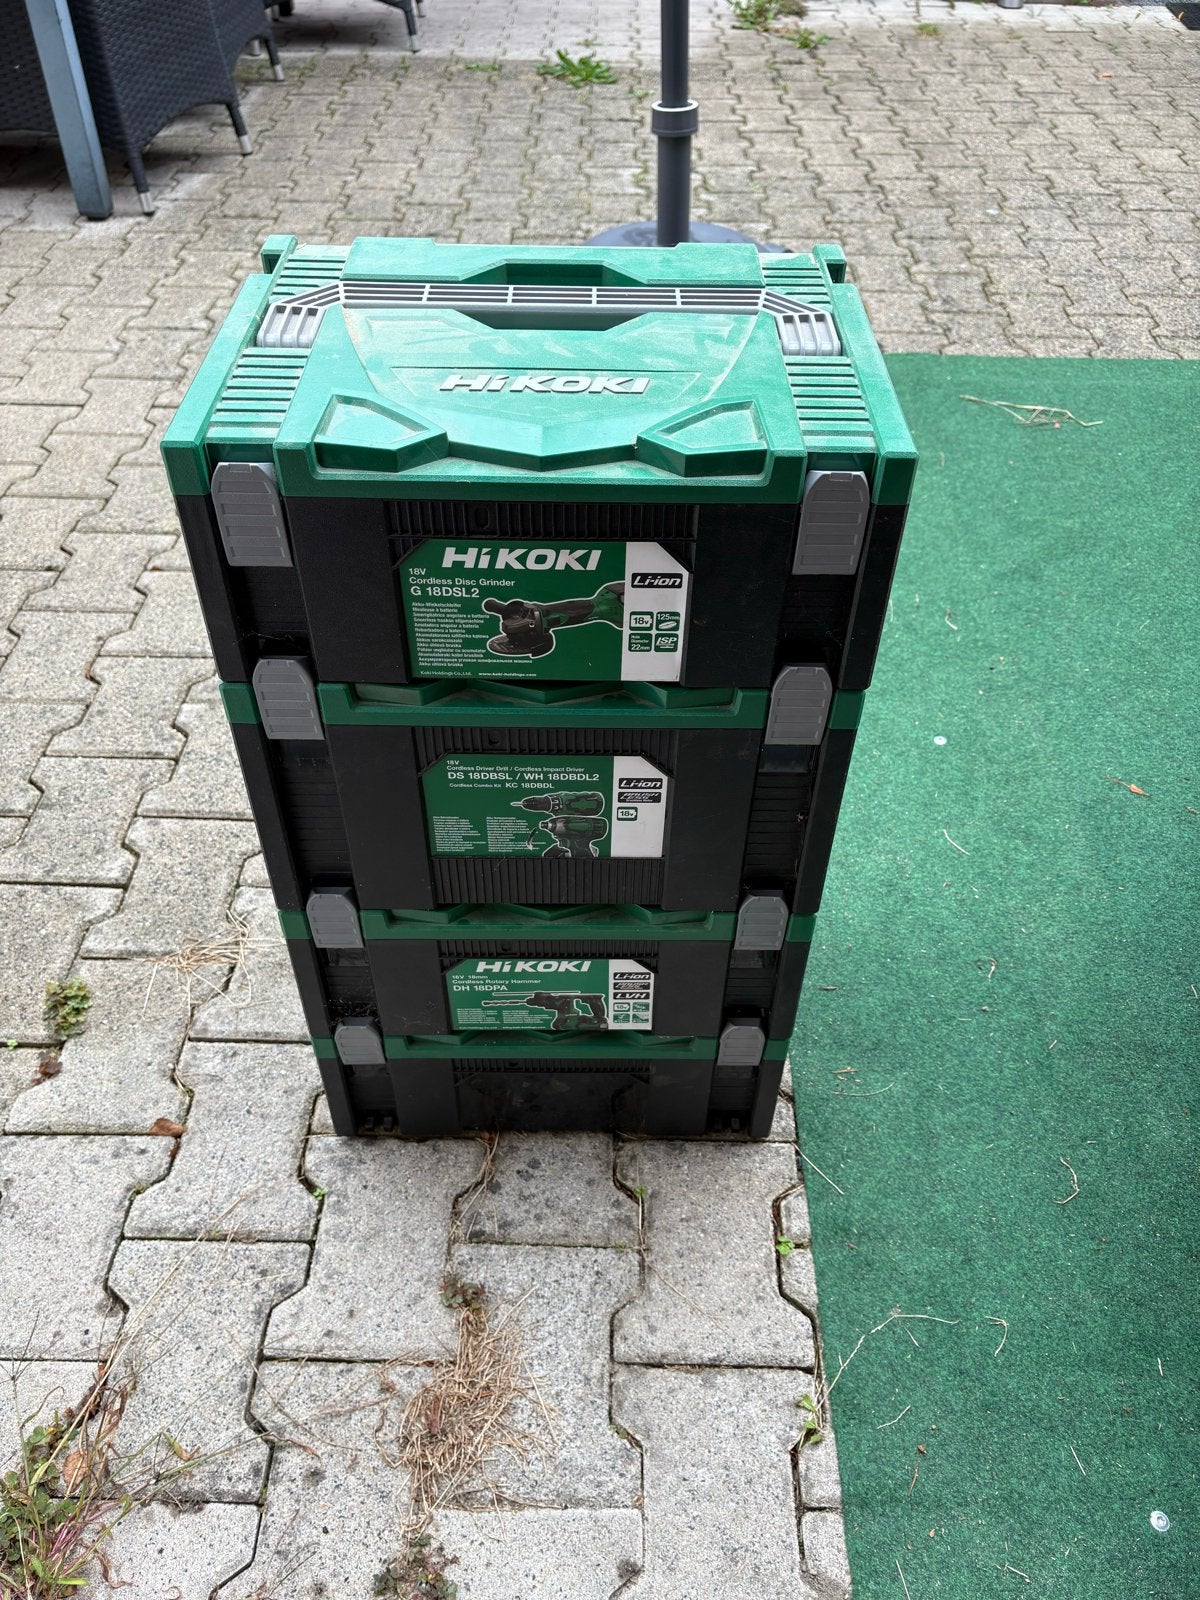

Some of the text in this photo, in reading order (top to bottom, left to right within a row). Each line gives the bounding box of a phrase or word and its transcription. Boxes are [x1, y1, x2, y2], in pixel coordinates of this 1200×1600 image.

[409, 576, 515, 587] Cordless Disc Grinder
[633, 576, 681, 586] Li-ion
[410, 586, 480, 598] G 18DSL2
